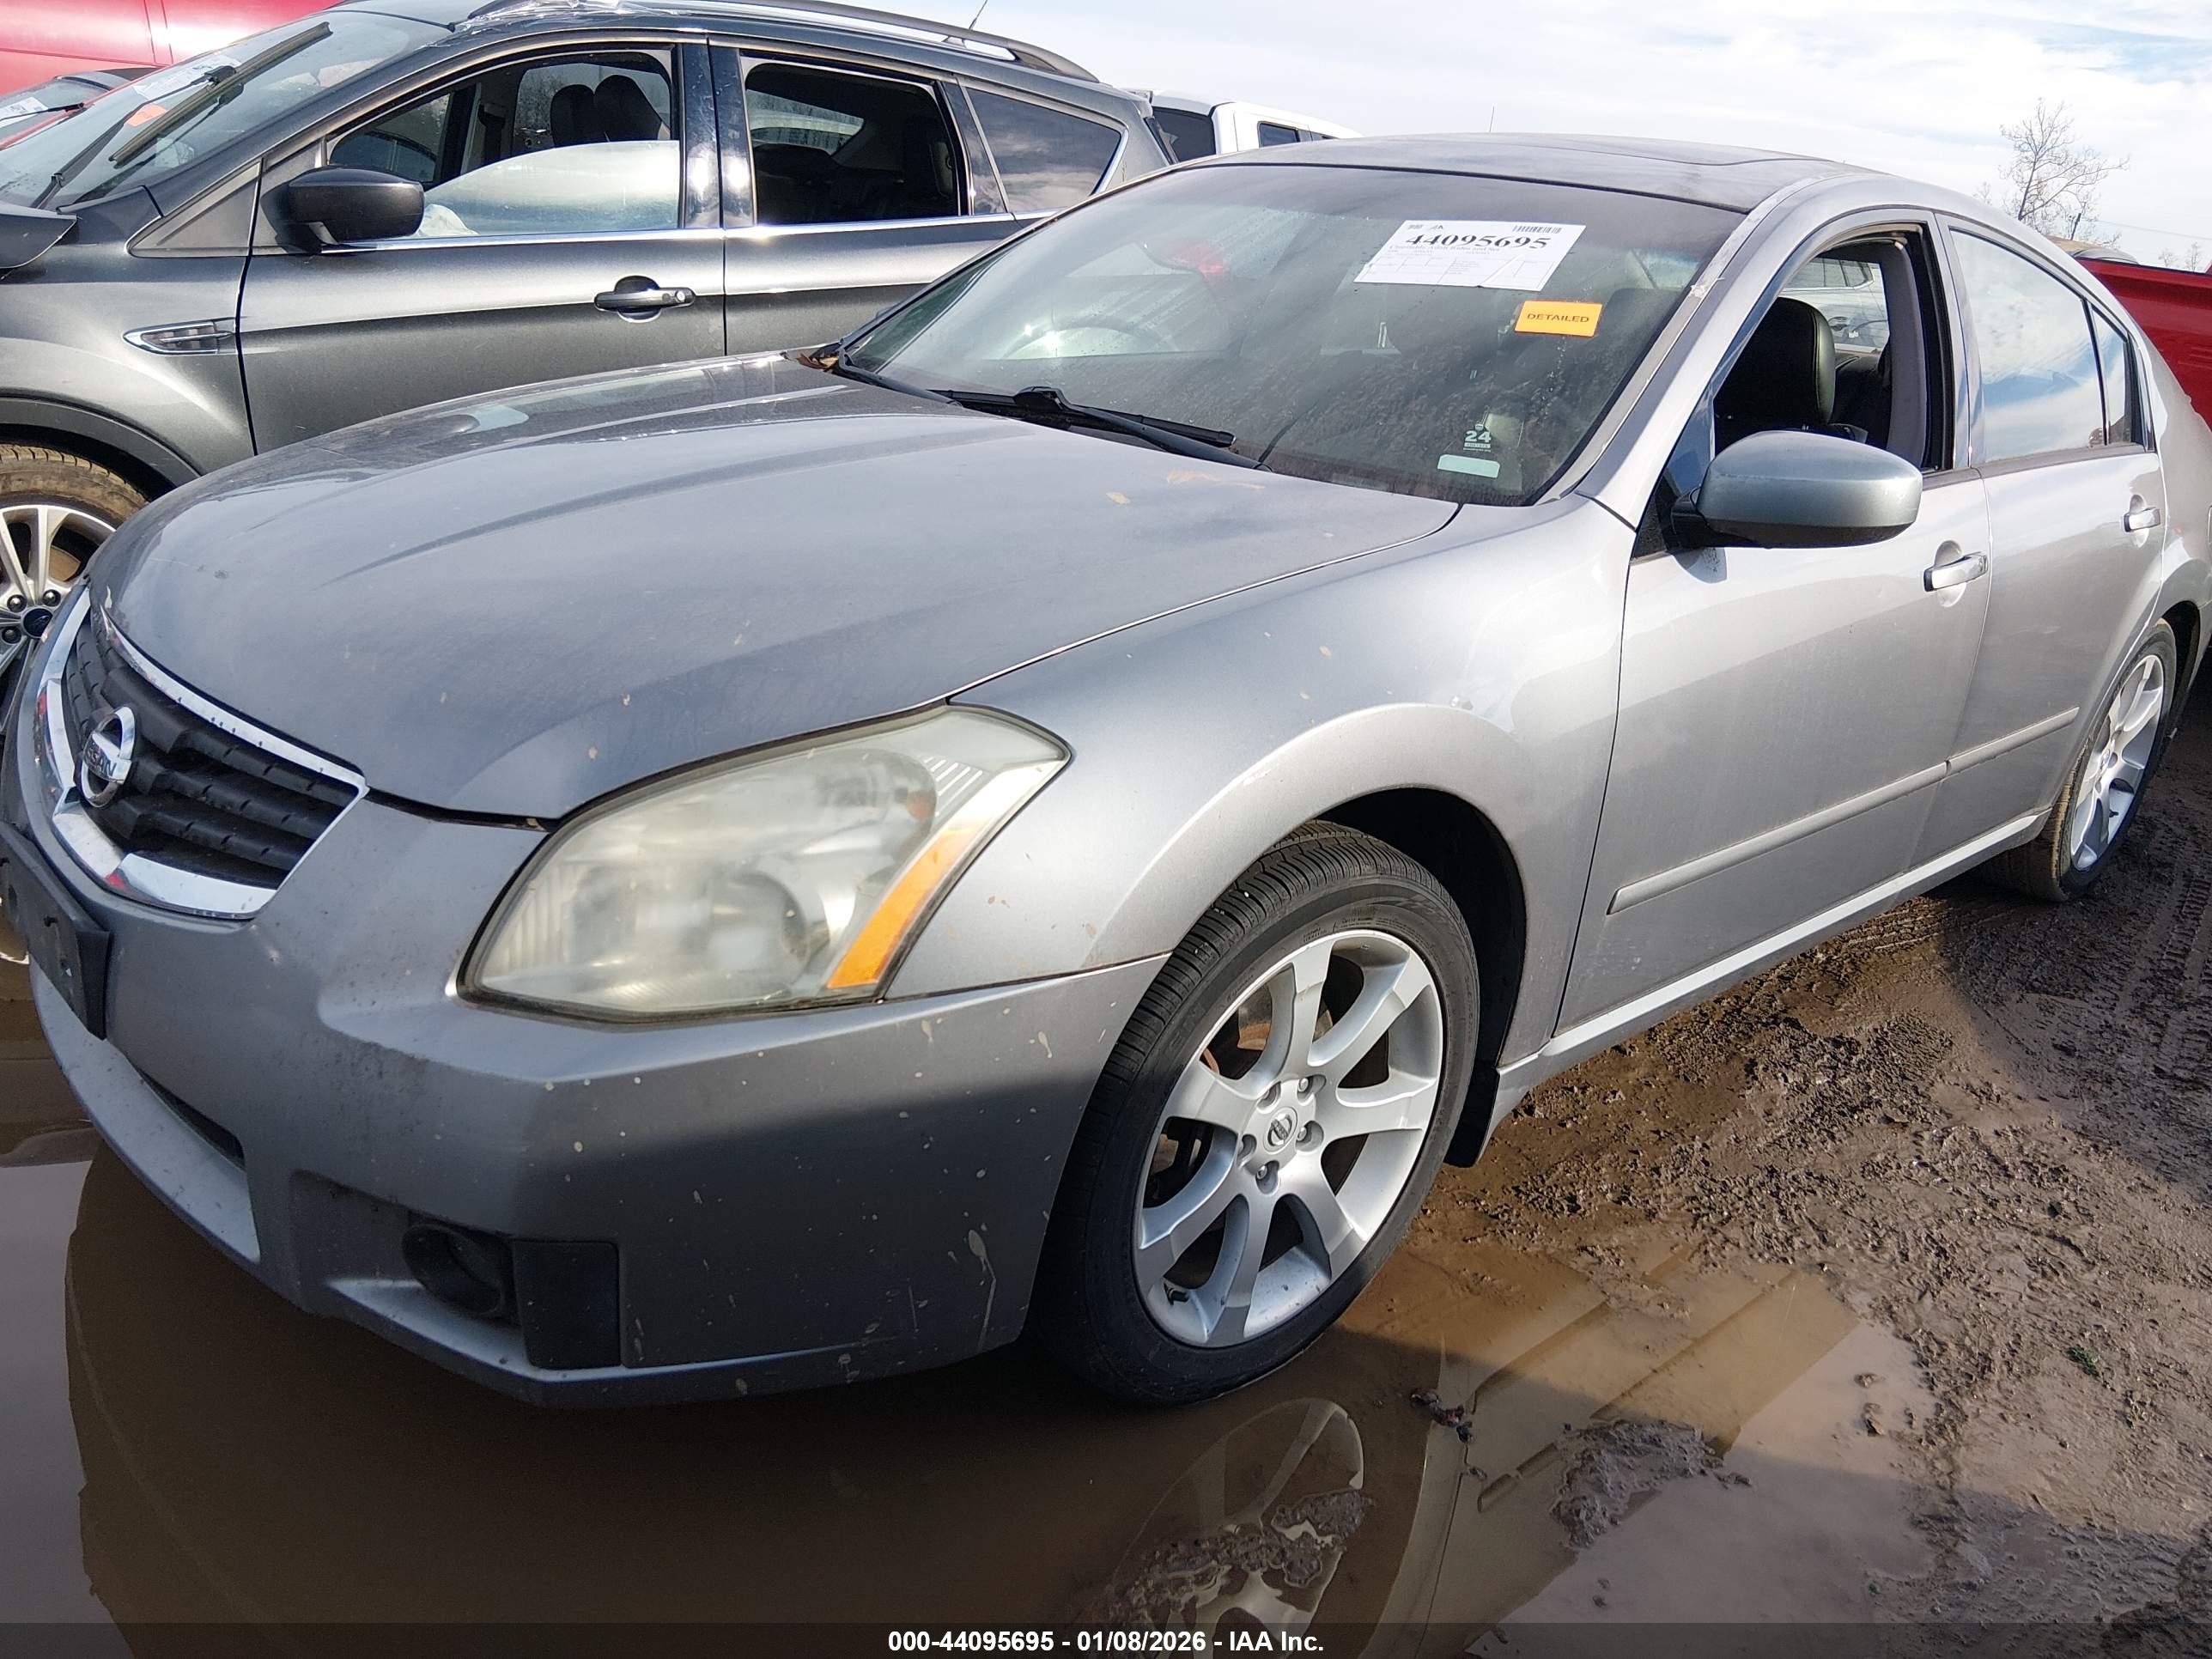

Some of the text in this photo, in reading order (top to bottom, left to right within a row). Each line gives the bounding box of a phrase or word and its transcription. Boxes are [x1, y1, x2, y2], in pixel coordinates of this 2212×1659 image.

[1405, 234, 1552, 249] 44095695
[1527, 313, 1589, 323] DETAILED
[1464, 430, 1492, 442] 24
